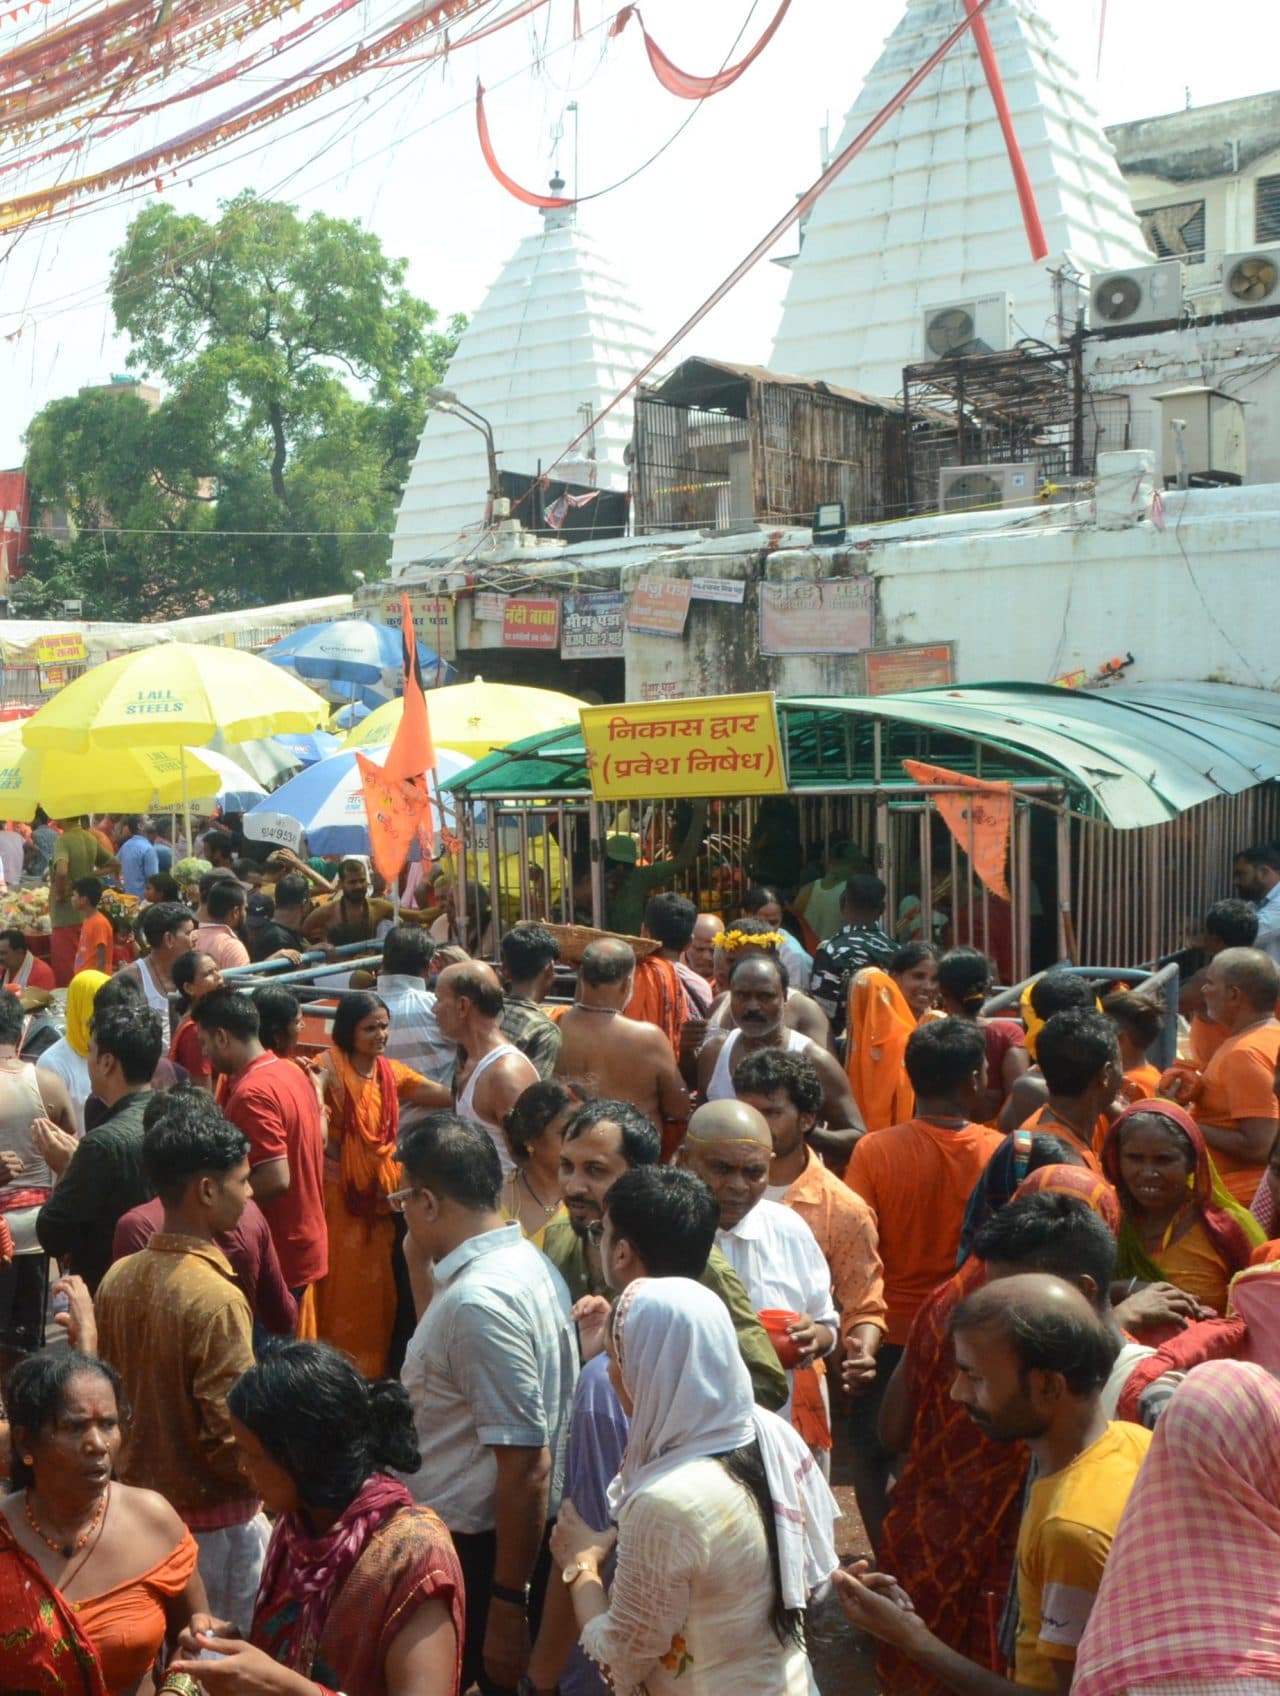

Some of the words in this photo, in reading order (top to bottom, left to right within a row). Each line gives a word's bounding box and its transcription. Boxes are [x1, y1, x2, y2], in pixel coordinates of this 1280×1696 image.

[505, 604, 527, 625] नंदी
[529, 608, 556, 625] बाबा
[126, 701, 184, 715] STEELS
[608, 716, 705, 742] निकास
[709, 714, 760, 741] द्वार
[602, 751, 681, 785] (प्रवेश
[686, 744, 776, 778] निषेध)
